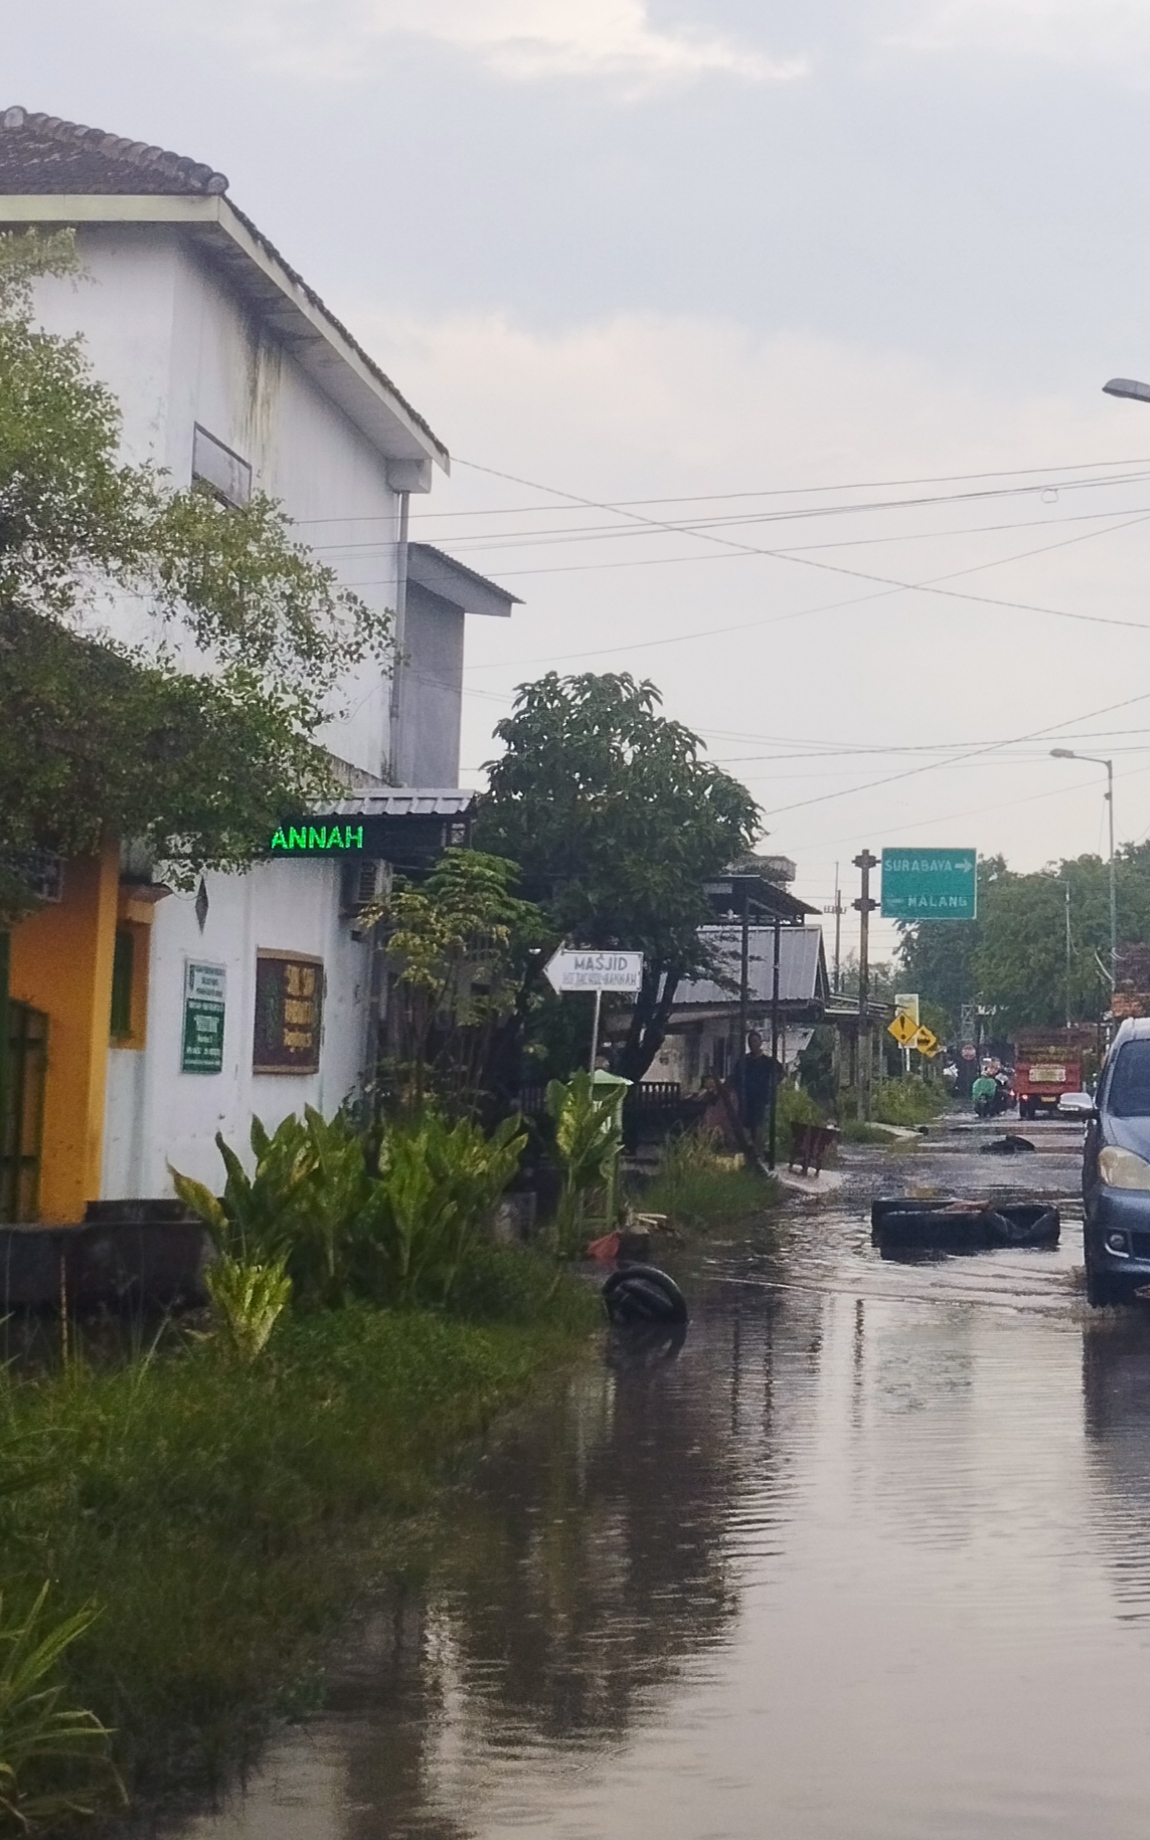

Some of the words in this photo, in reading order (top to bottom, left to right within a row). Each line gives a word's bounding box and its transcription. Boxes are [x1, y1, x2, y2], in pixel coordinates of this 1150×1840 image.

[270, 826, 363, 849] ANNAH
[885, 860, 952, 871] SURABAYA
[908, 896, 967, 907] MALANG
[574, 956, 628, 971] MASJID
